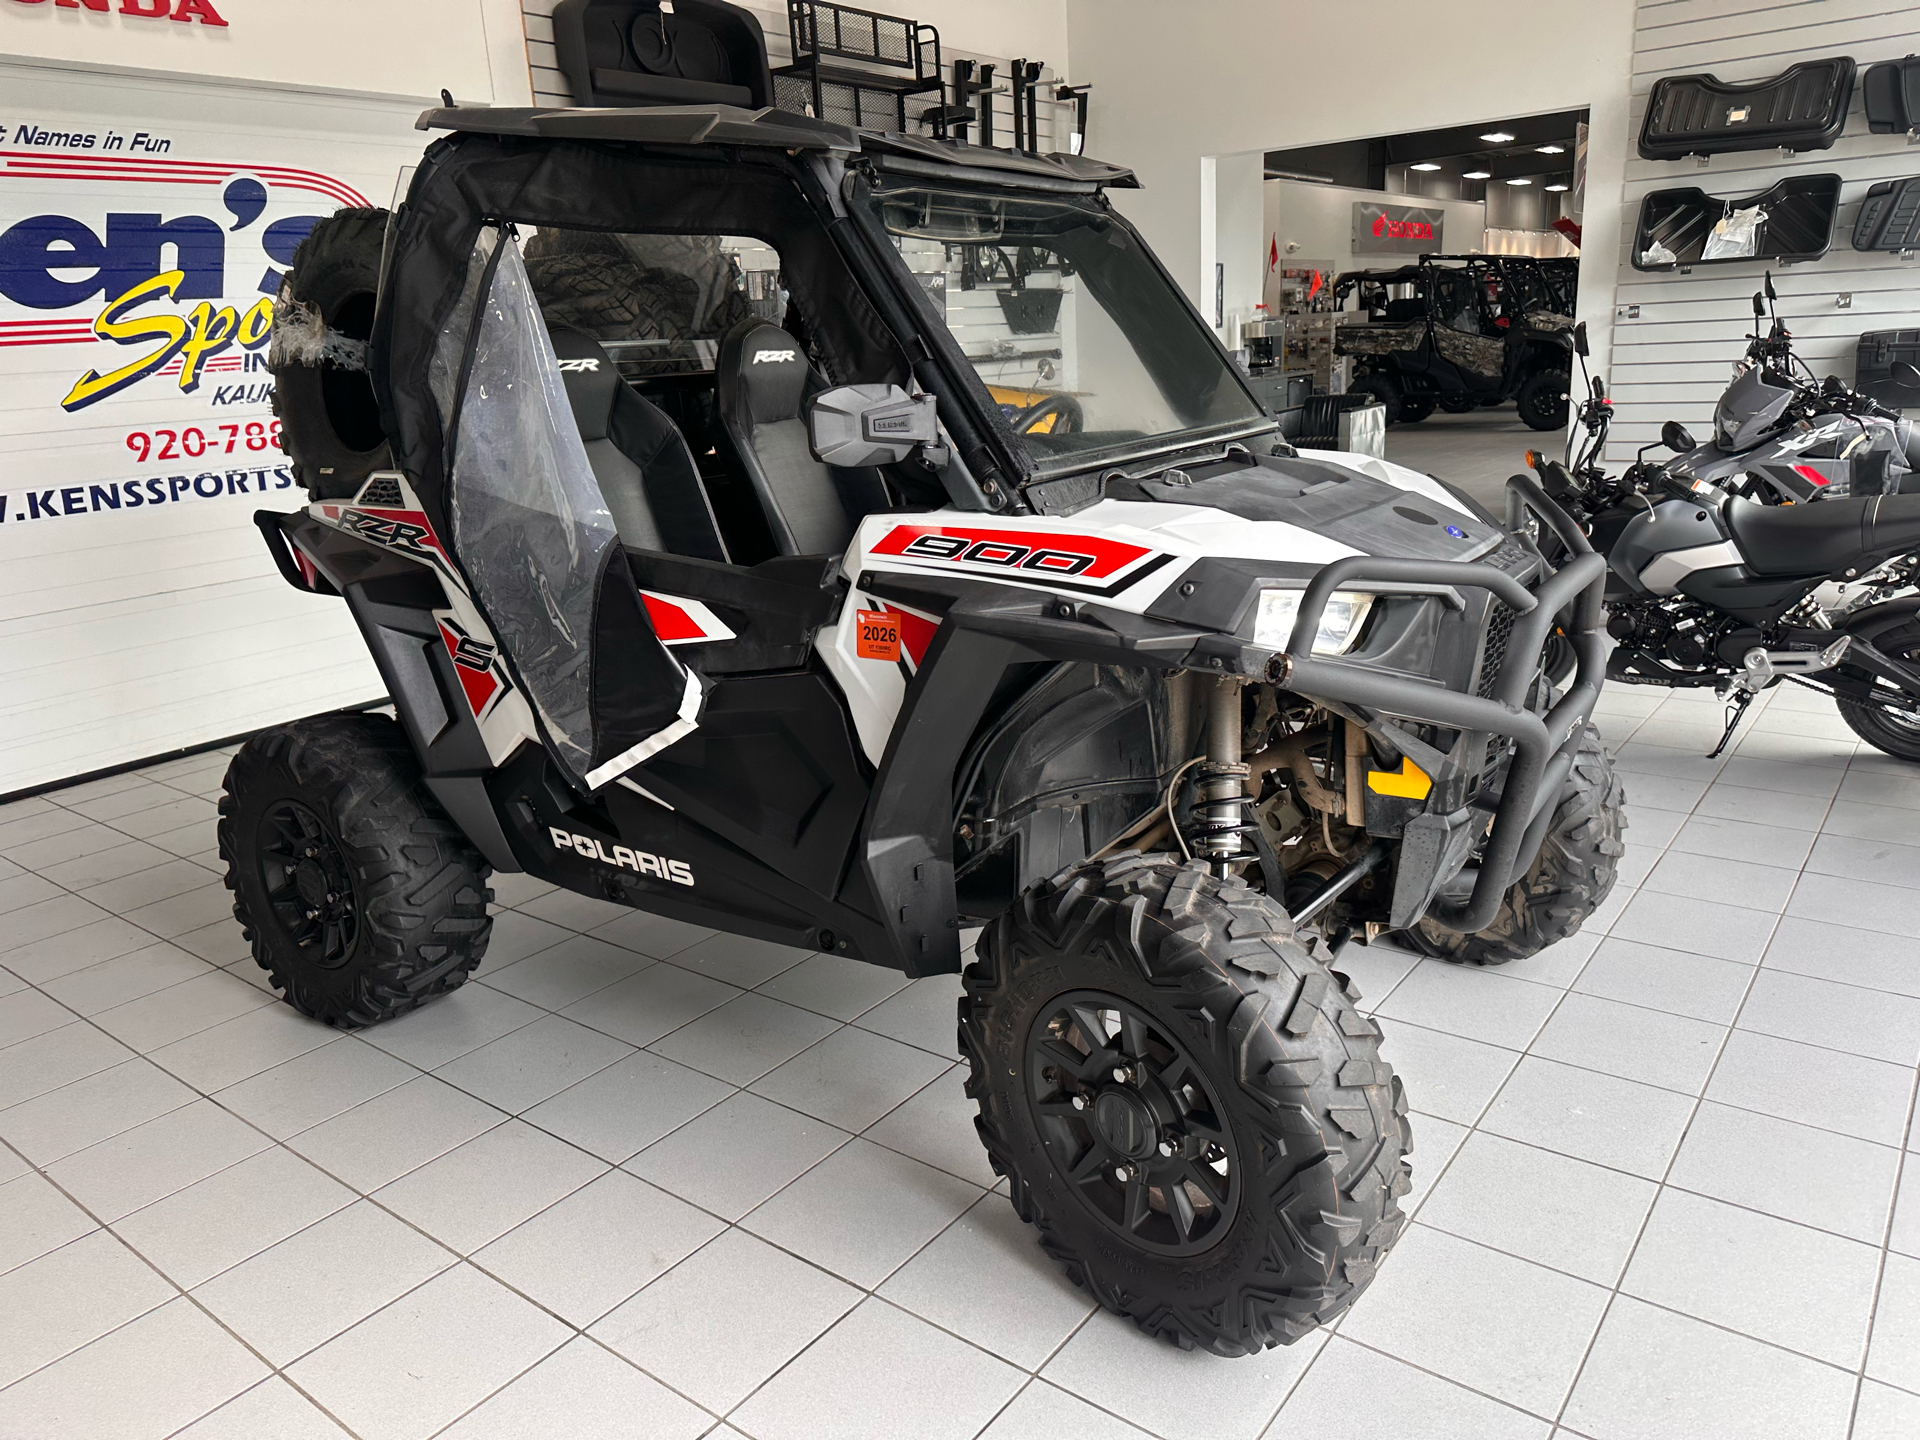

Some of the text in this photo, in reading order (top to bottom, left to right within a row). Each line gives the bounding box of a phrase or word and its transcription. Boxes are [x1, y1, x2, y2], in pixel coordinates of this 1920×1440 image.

[14, 124, 97, 148] Names
[103, 131, 124, 150] in
[129, 132, 171, 152] Fun
[1387, 220, 1433, 239] HONDA
[557, 358, 600, 372] ZR
[753, 350, 796, 364] RZR
[337, 507, 430, 552] RZR
[901, 534, 1097, 578] 900
[863, 625, 897, 643] 2026
[549, 826, 695, 887] POLARIS
